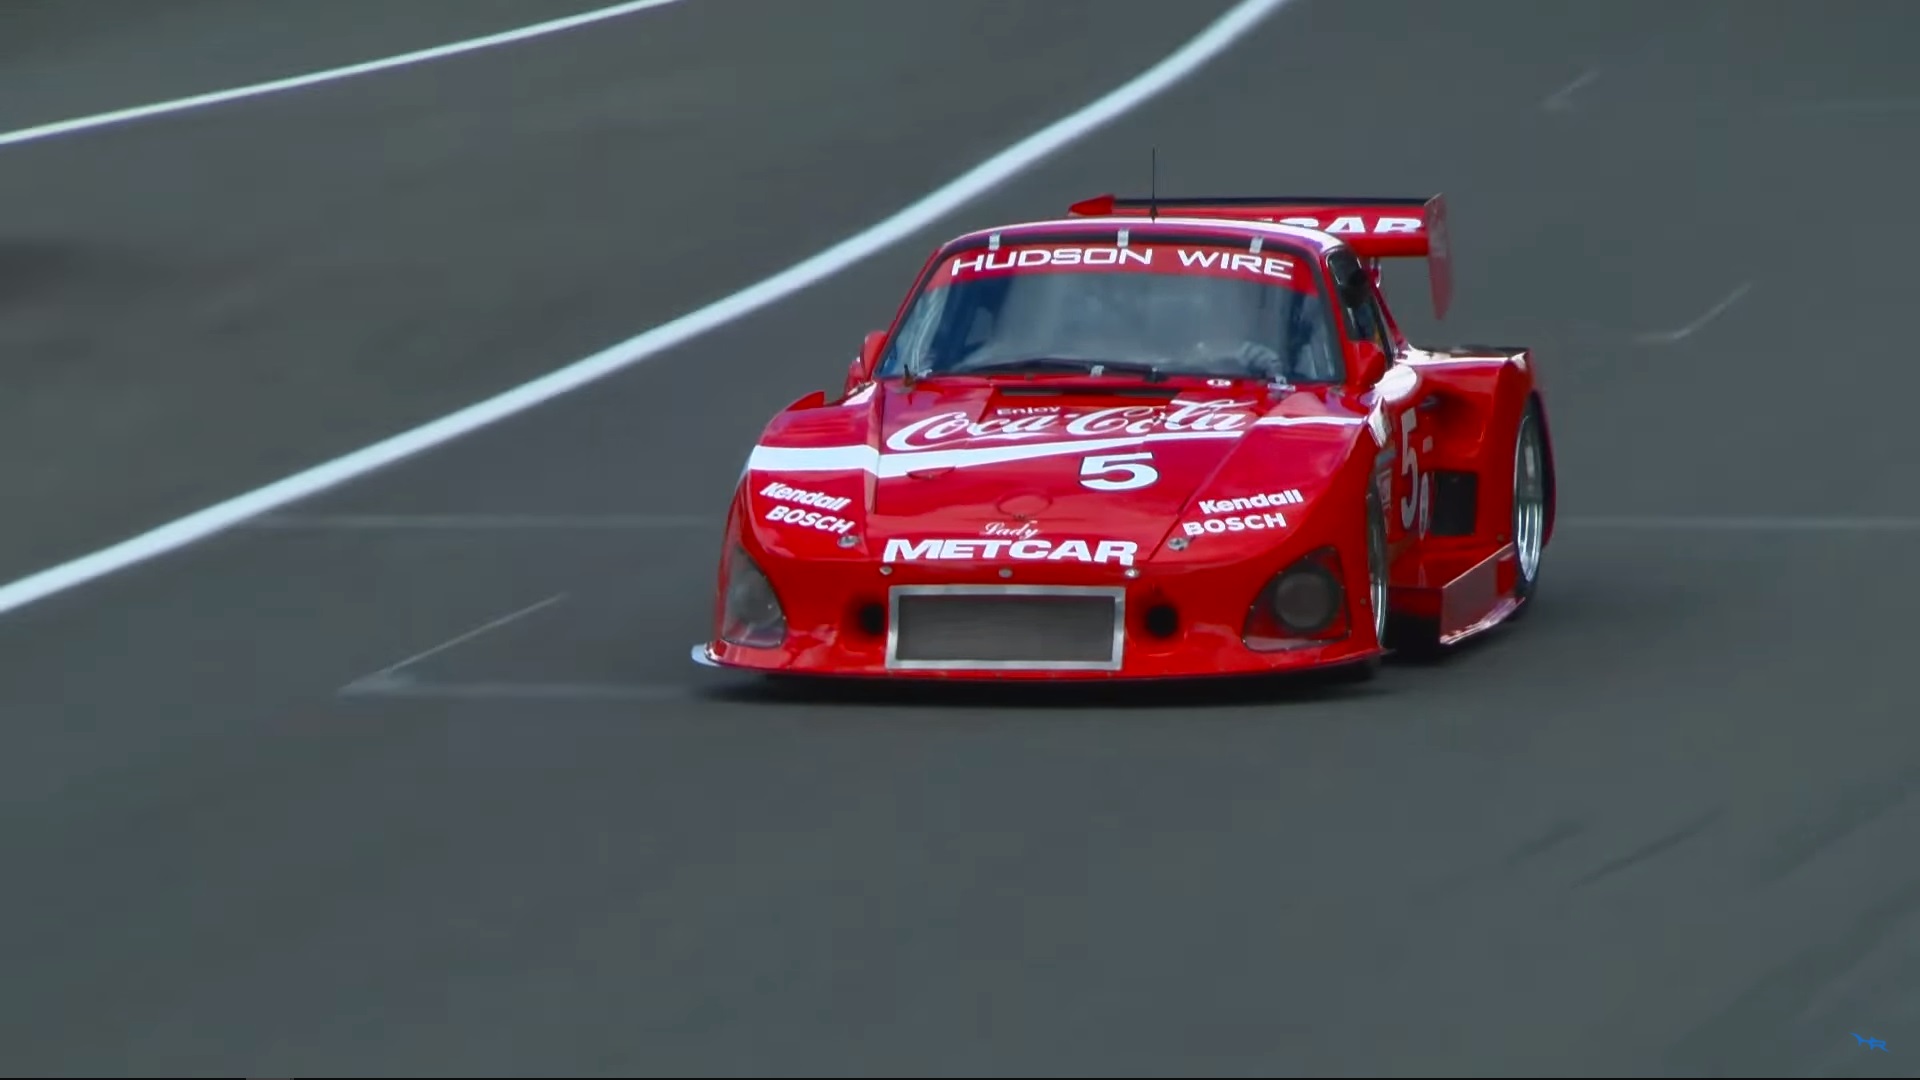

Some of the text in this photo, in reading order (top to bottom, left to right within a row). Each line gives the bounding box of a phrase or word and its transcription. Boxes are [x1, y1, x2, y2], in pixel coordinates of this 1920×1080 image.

[951, 247, 1295, 280] HUDSON WIRE
[886, 399, 1258, 452] Coca-Cola
[995, 405, 1061, 417] Enjoy
[1078, 451, 1159, 491] 5
[759, 481, 852, 512] Kendall
[1198, 488, 1304, 515] Kendall
[764, 504, 856, 535] BOSCH
[983, 520, 1040, 540] Lady
[1181, 511, 1287, 537] BOSCH
[882, 538, 1139, 567] METCAR
